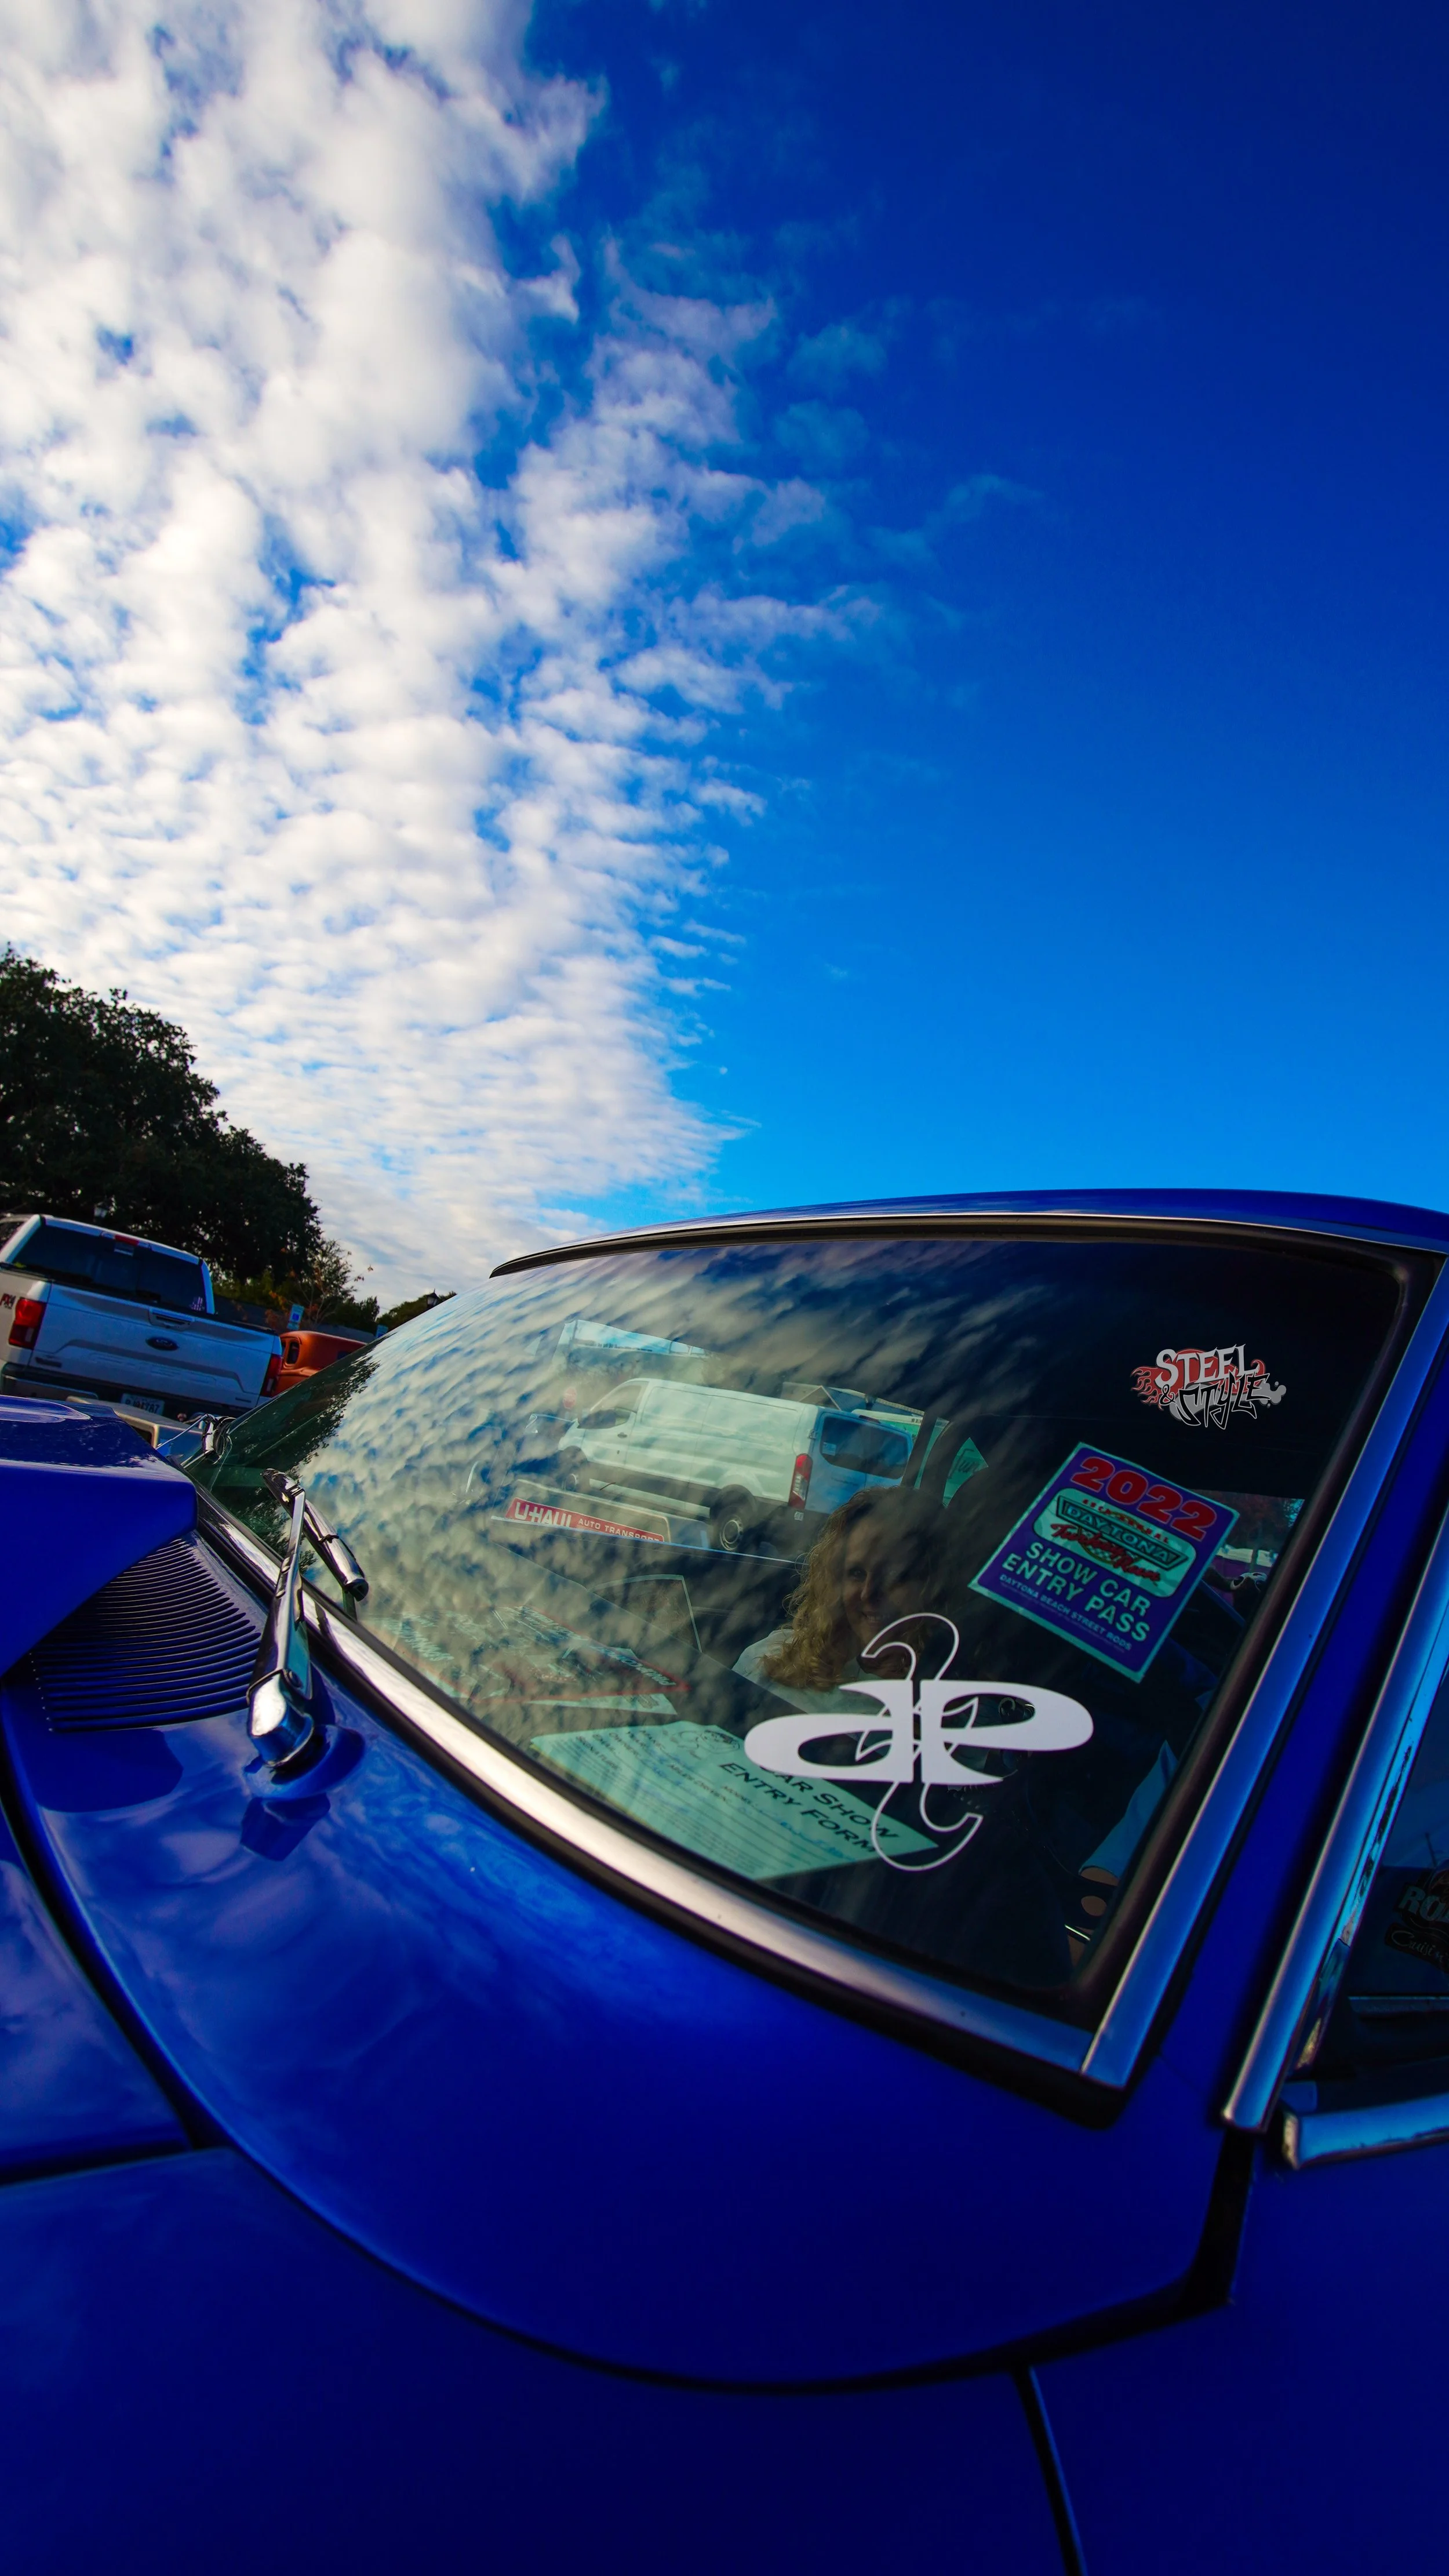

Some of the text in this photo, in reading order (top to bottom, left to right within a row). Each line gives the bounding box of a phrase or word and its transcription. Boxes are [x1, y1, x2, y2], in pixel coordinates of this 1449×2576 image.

[1155, 1343, 1260, 1389] STEEL
[1159, 1371, 1270, 1430] & STYLE
[578, 1518, 600, 1530] AUTO
[1071, 1456, 1217, 1541] 2022
[1067, 1506, 1170, 1561] DAYTONA
[999, 1574, 1039, 1598] DAYTONA
[1040, 1594, 1071, 1615] BEACH
[1071, 1611, 1106, 1634] STREET
[1002, 1553, 1084, 1601] ENTRY
[1084, 1594, 1150, 1641] PASS
[1026, 1542, 1151, 1616] SHOW CAR
[719, 1762, 802, 1807] ENTRY
[801, 1809, 881, 1853] FORM
[814, 1793, 900, 1839] SHOW
